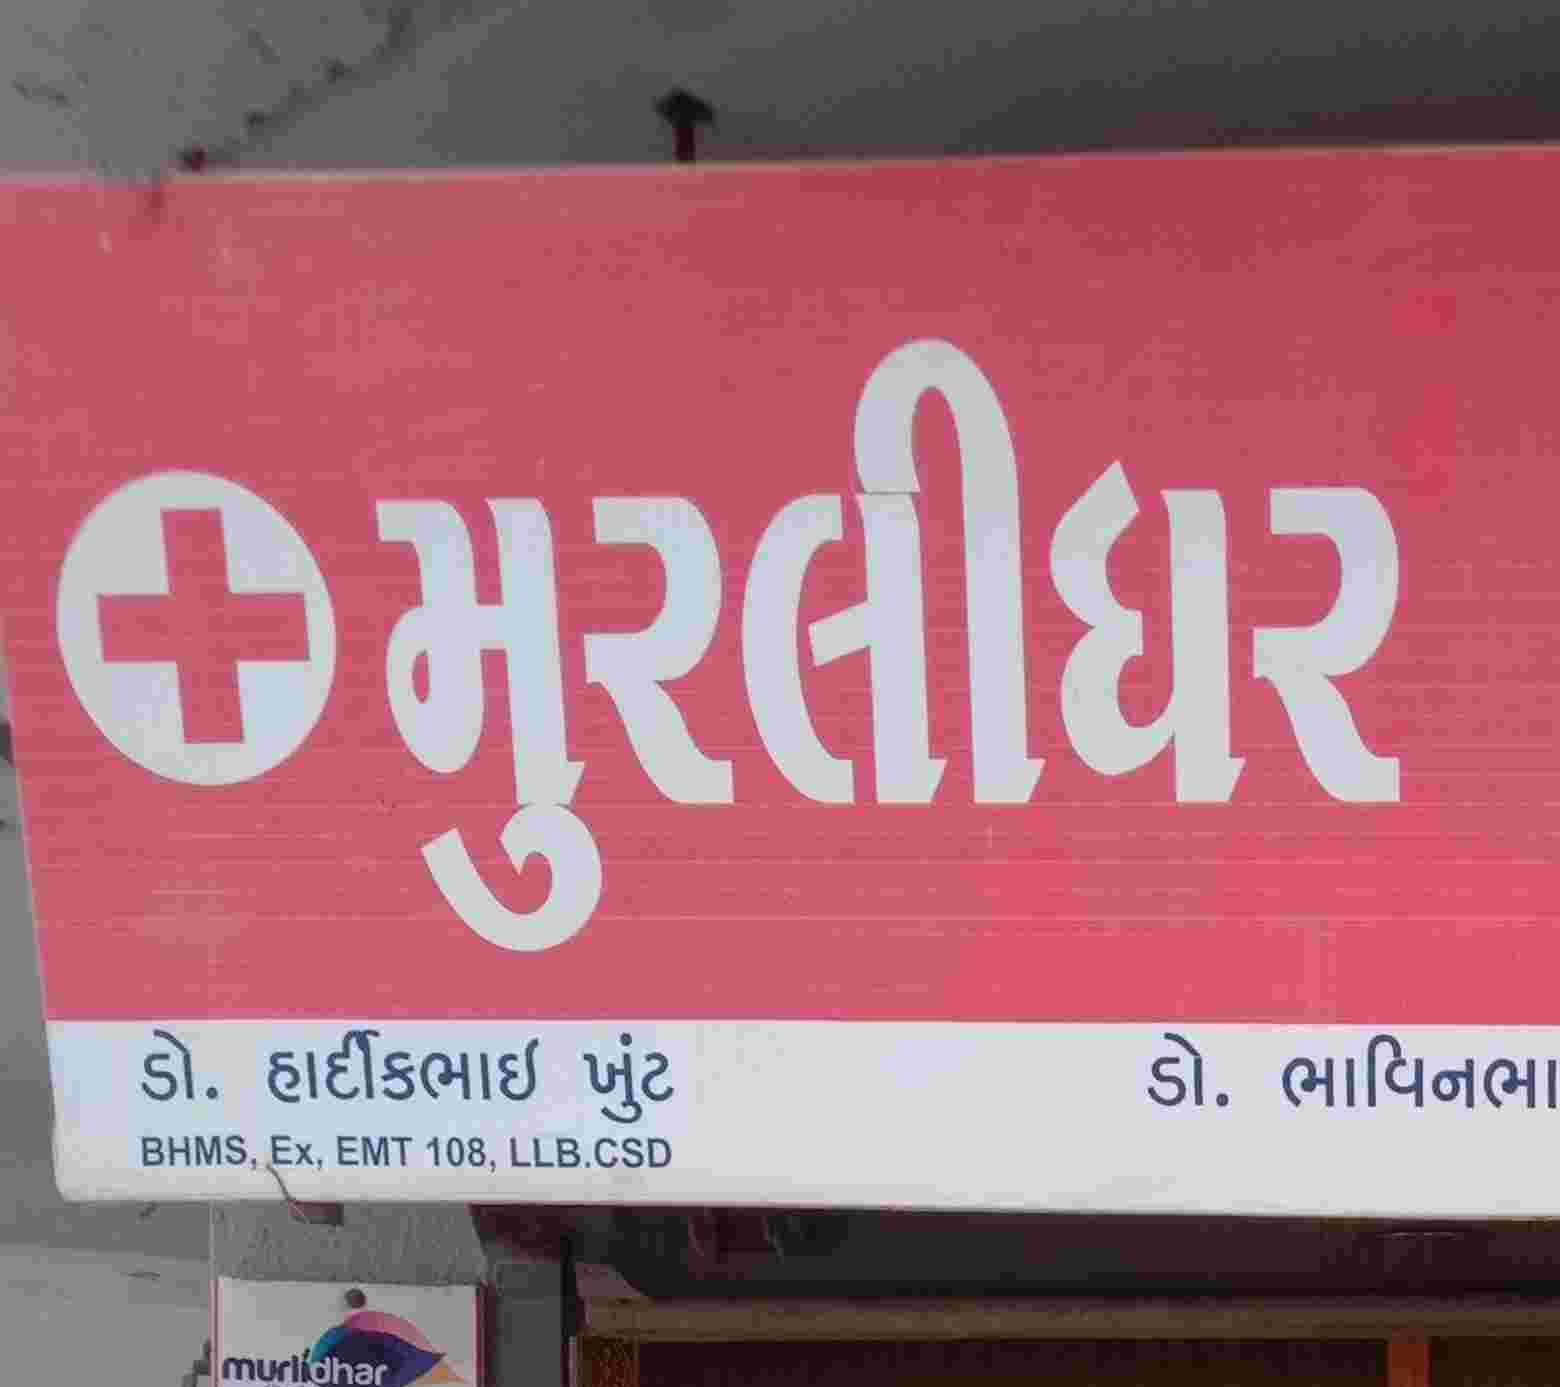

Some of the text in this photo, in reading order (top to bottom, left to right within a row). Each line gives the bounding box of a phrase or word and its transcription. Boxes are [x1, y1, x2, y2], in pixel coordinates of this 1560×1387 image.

[377, 338, 1400, 951] મુરલીધર
[142, 1029, 218, 1100] ડો.
[582, 1033, 674, 1123] ખુંટ
[1147, 1033, 1230, 1108] ડો.
[142, 1137, 673, 1172] BHMS, Ex, EMT 108, LLB.CSD
[222, 1348, 388, 1386] murlidhar
